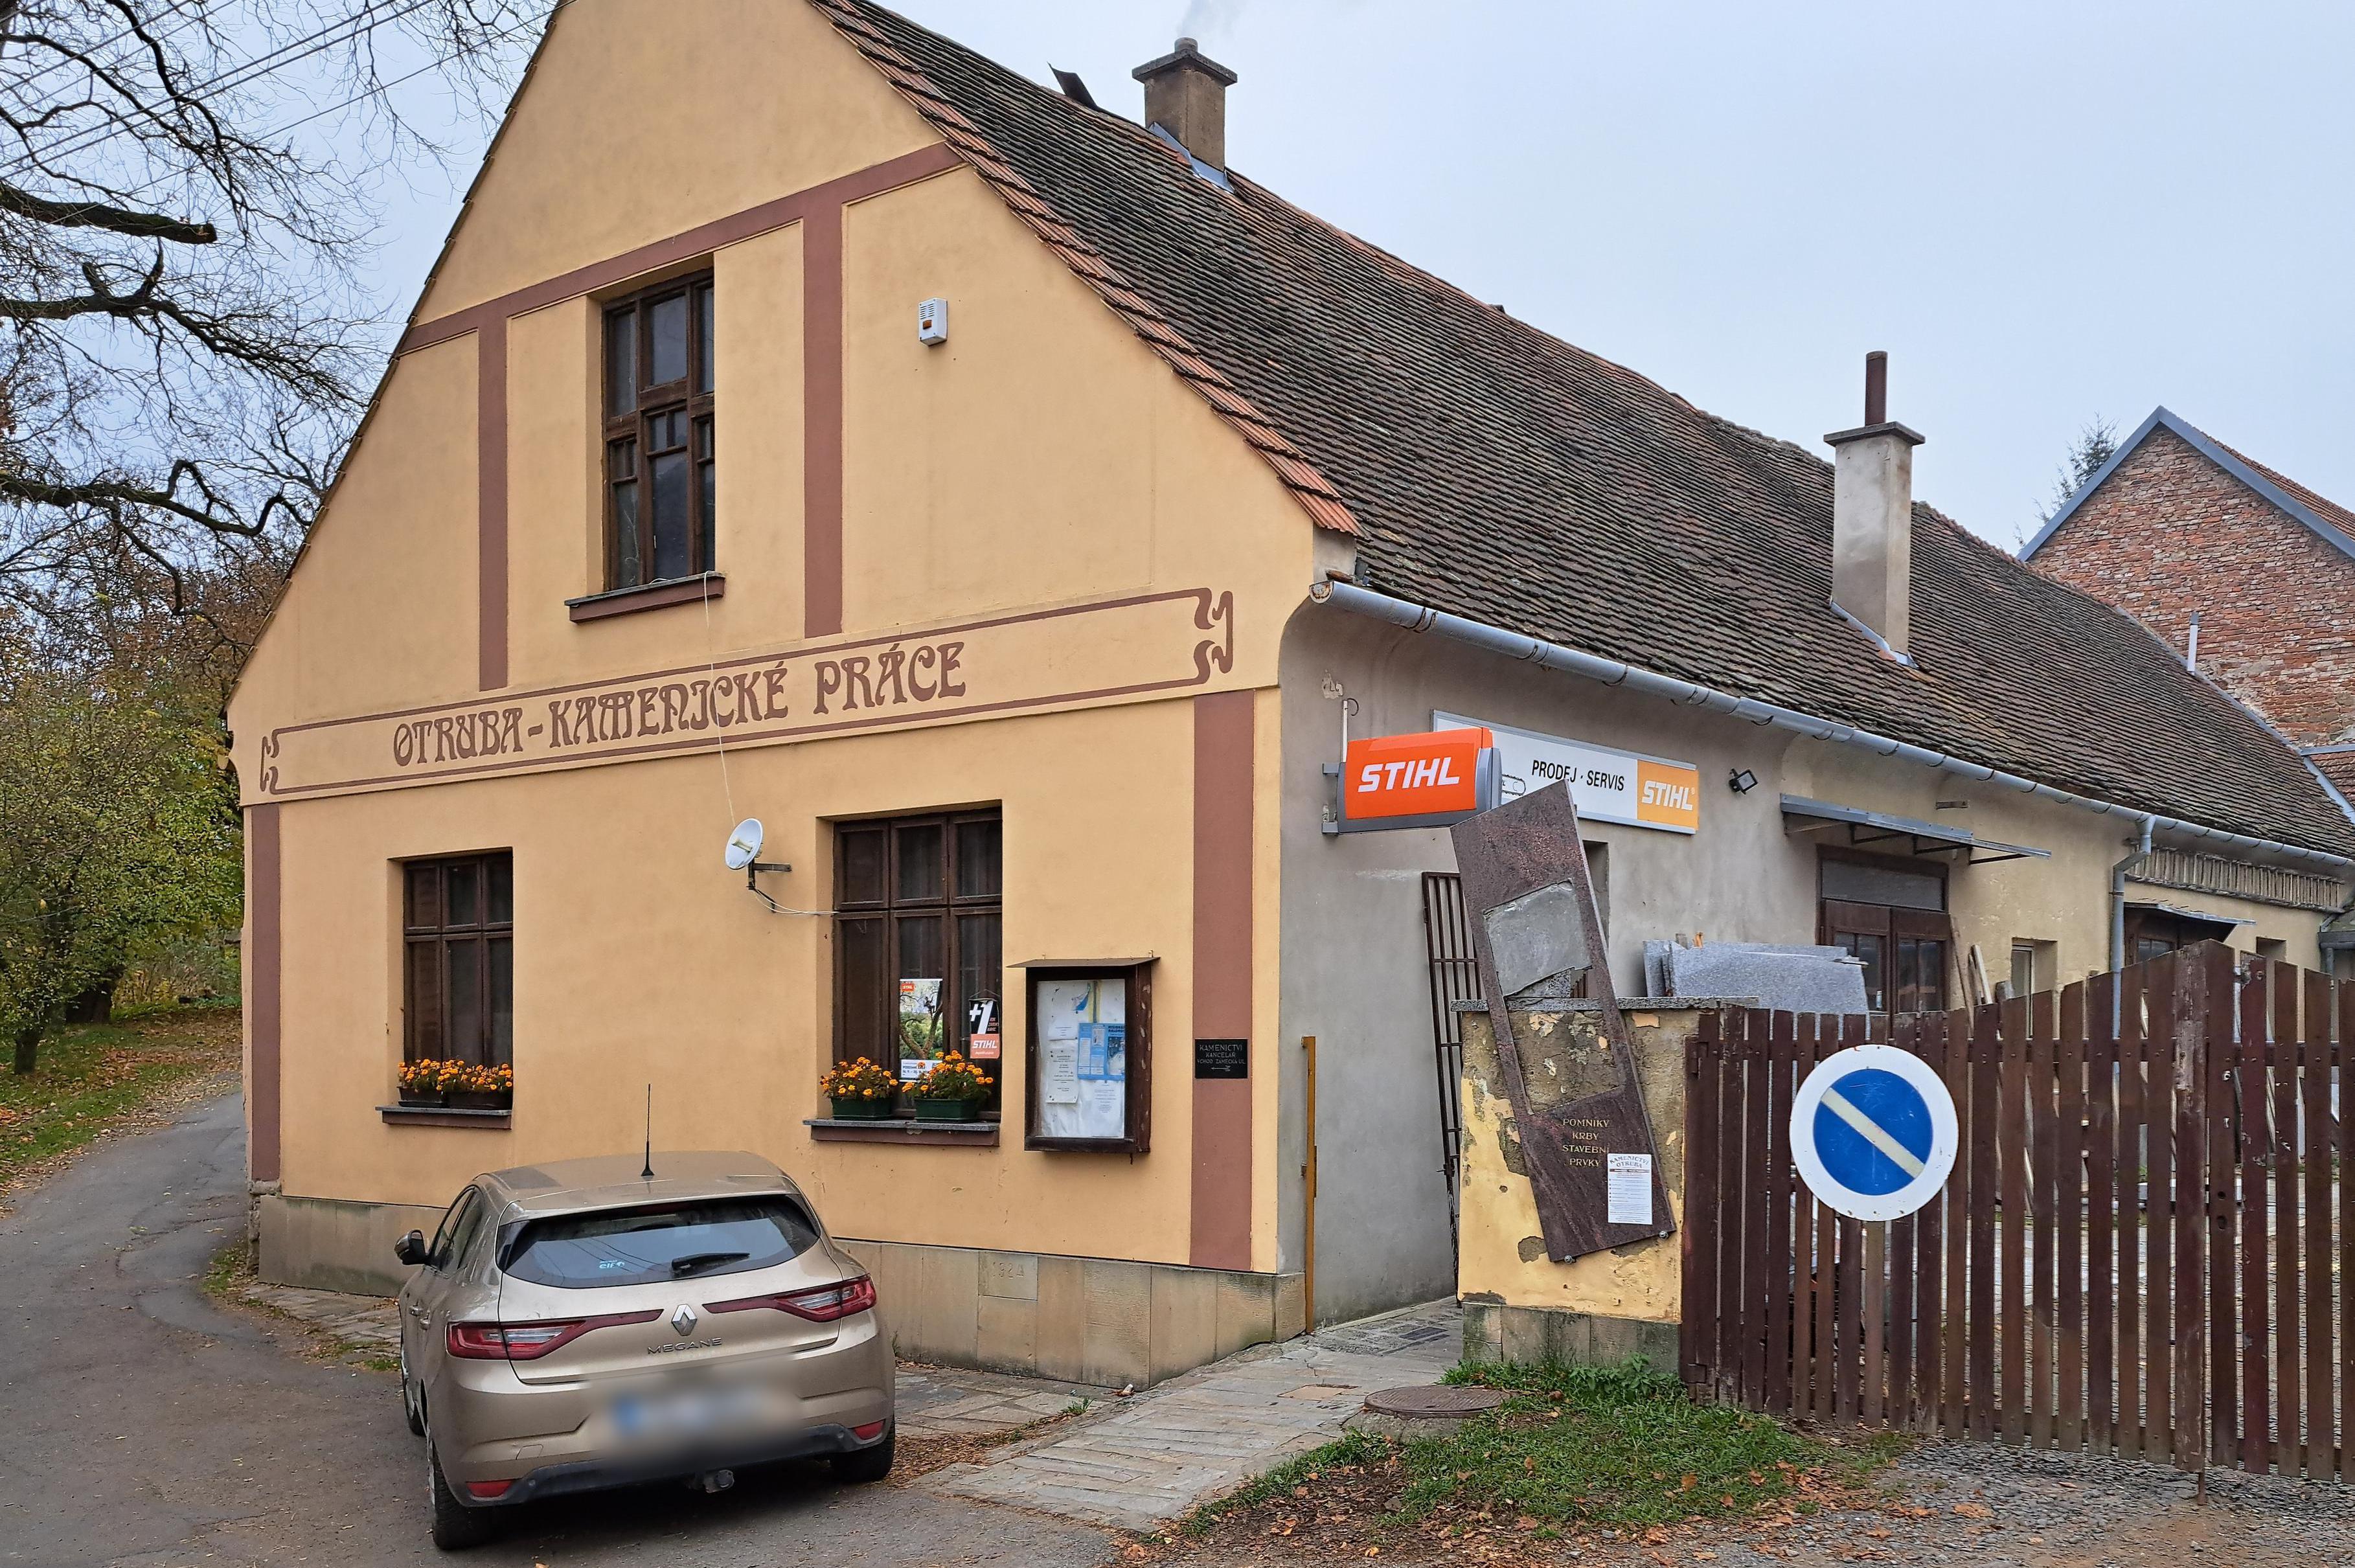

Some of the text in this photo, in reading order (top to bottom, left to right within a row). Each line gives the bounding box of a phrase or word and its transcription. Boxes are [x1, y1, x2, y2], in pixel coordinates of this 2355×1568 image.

[813, 641, 967, 715] PRÁCE
[1357, 756, 1461, 793] STIHL
[1532, 760, 1577, 783] PRODEJ
[1586, 770, 1625, 791] SERVIS
[972, 1040, 998, 1049] STIHL
[1573, 1131, 1599, 1141] KRBY
[1569, 1158, 1601, 1167] PRVKY
[648, 1337, 722, 1354] MEGANE
